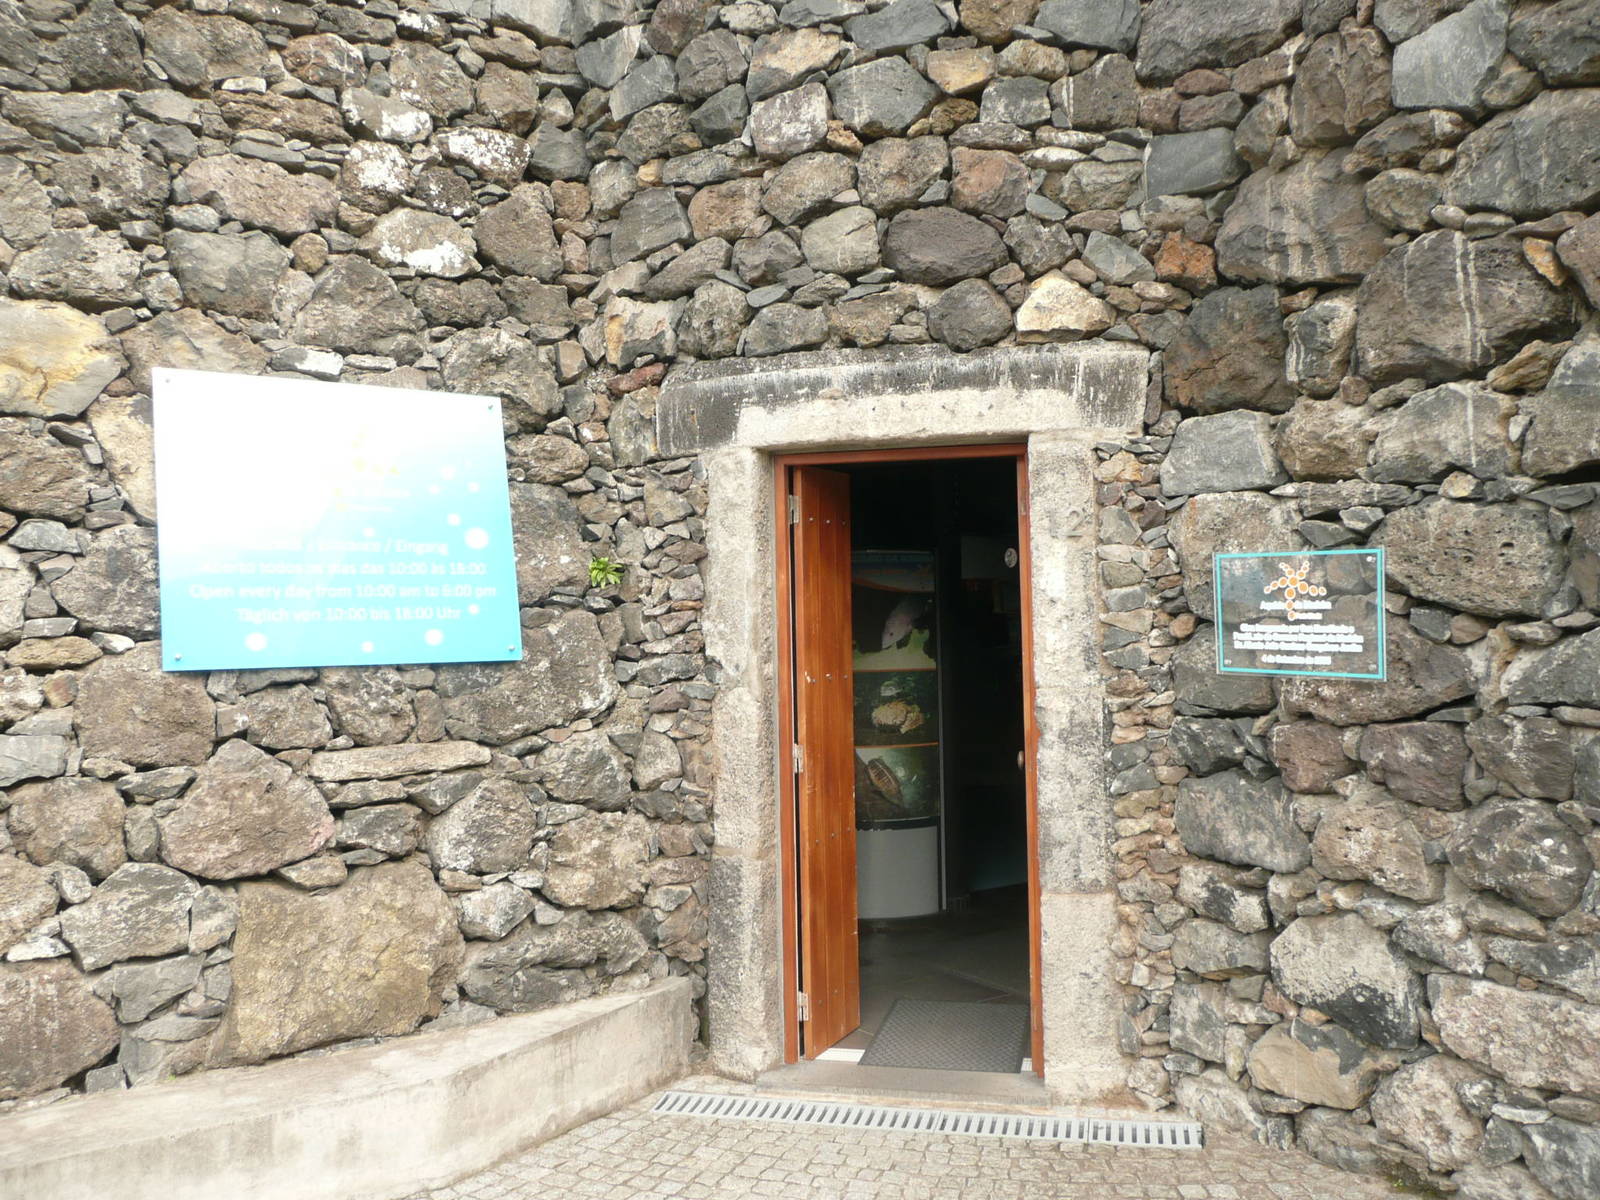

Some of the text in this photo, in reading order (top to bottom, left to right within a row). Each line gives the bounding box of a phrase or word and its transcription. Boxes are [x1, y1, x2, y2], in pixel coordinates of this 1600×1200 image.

[189, 584, 235, 600] Open
[239, 586, 280, 600] every
[285, 584, 312, 600] day
[315, 584, 352, 597] from
[354, 584, 396, 597] 10:00
[475, 586, 497, 599] pm
[293, 610, 320, 622] von
[324, 607, 368, 621] 10:00
[395, 607, 433, 621] 18:00
[436, 607, 463, 620] Uhr
